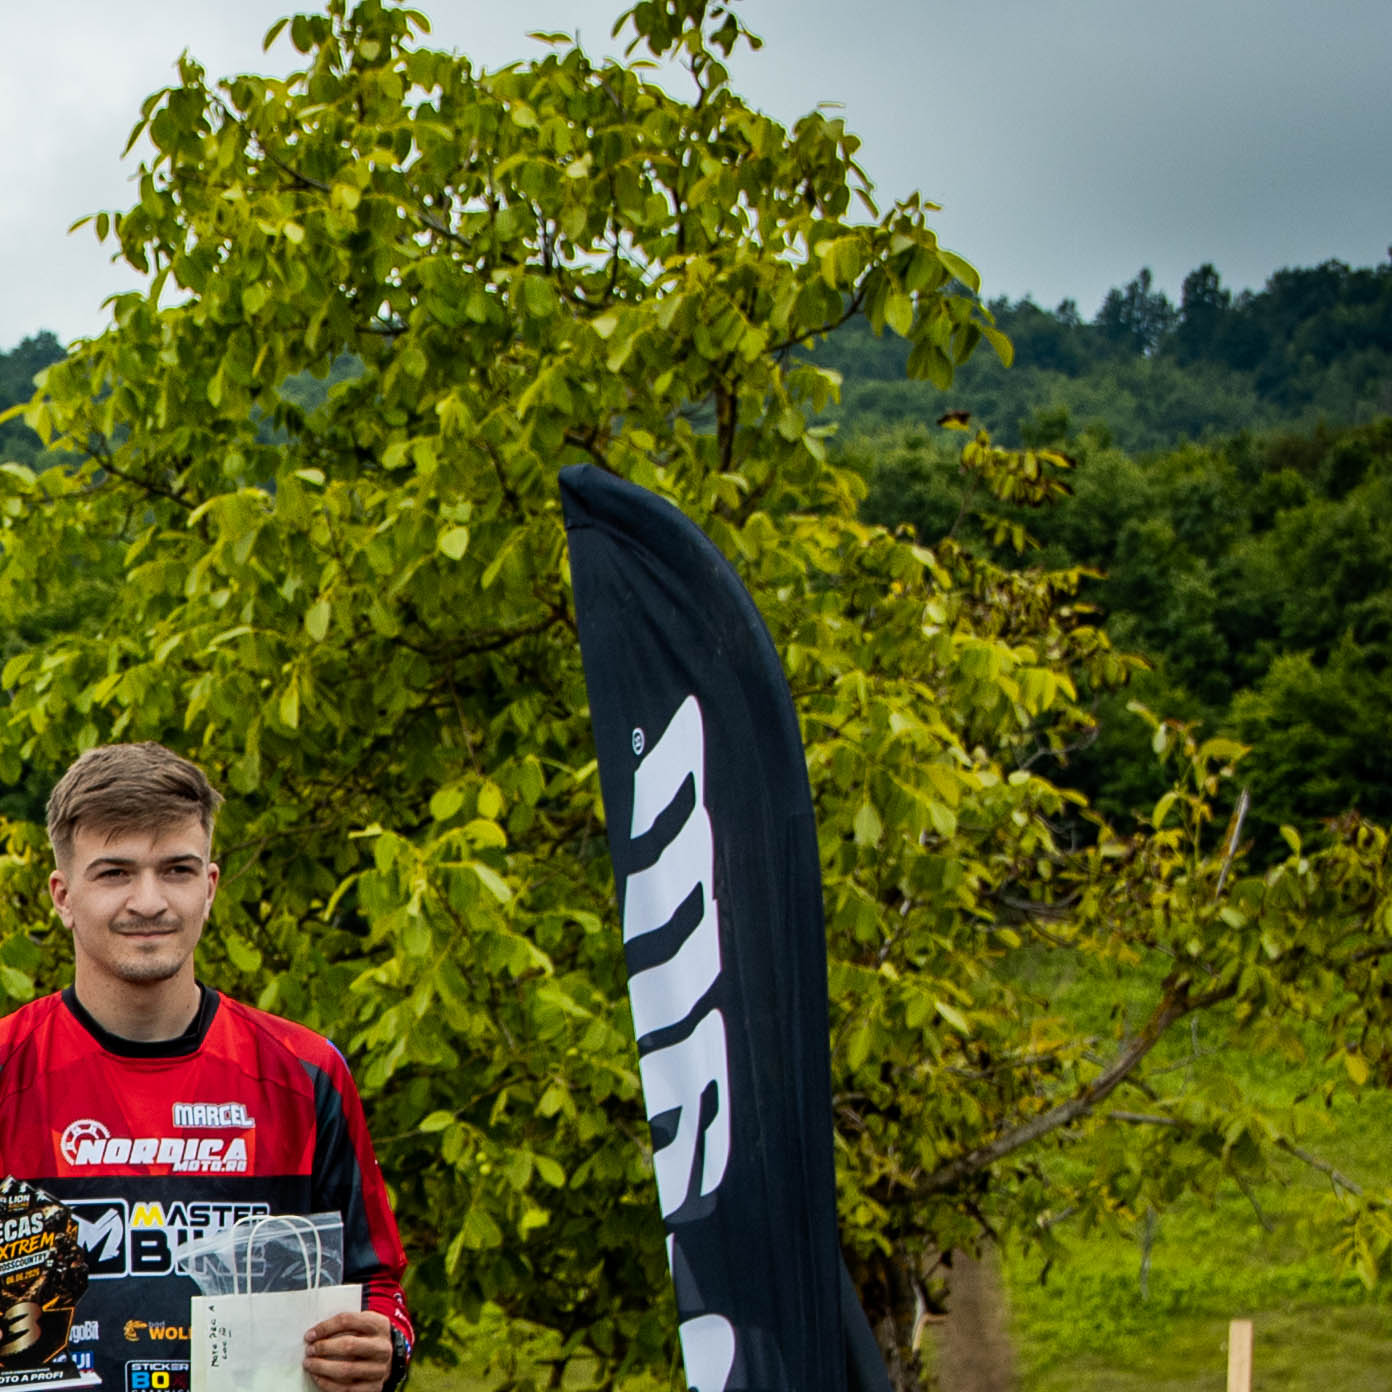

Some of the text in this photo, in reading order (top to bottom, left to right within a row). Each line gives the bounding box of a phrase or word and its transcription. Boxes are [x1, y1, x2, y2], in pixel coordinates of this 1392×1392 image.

[173, 1102, 255, 1128] MARCEL
[75, 1138, 247, 1165] NORDICA
[172, 1160, 247, 1173] MOTO.RO
[8, 1194, 31, 1204] LION
[131, 1363, 190, 1371] STICKER
[19, 1373, 29, 1383] A
[31, 1371, 64, 1382] PROFI
